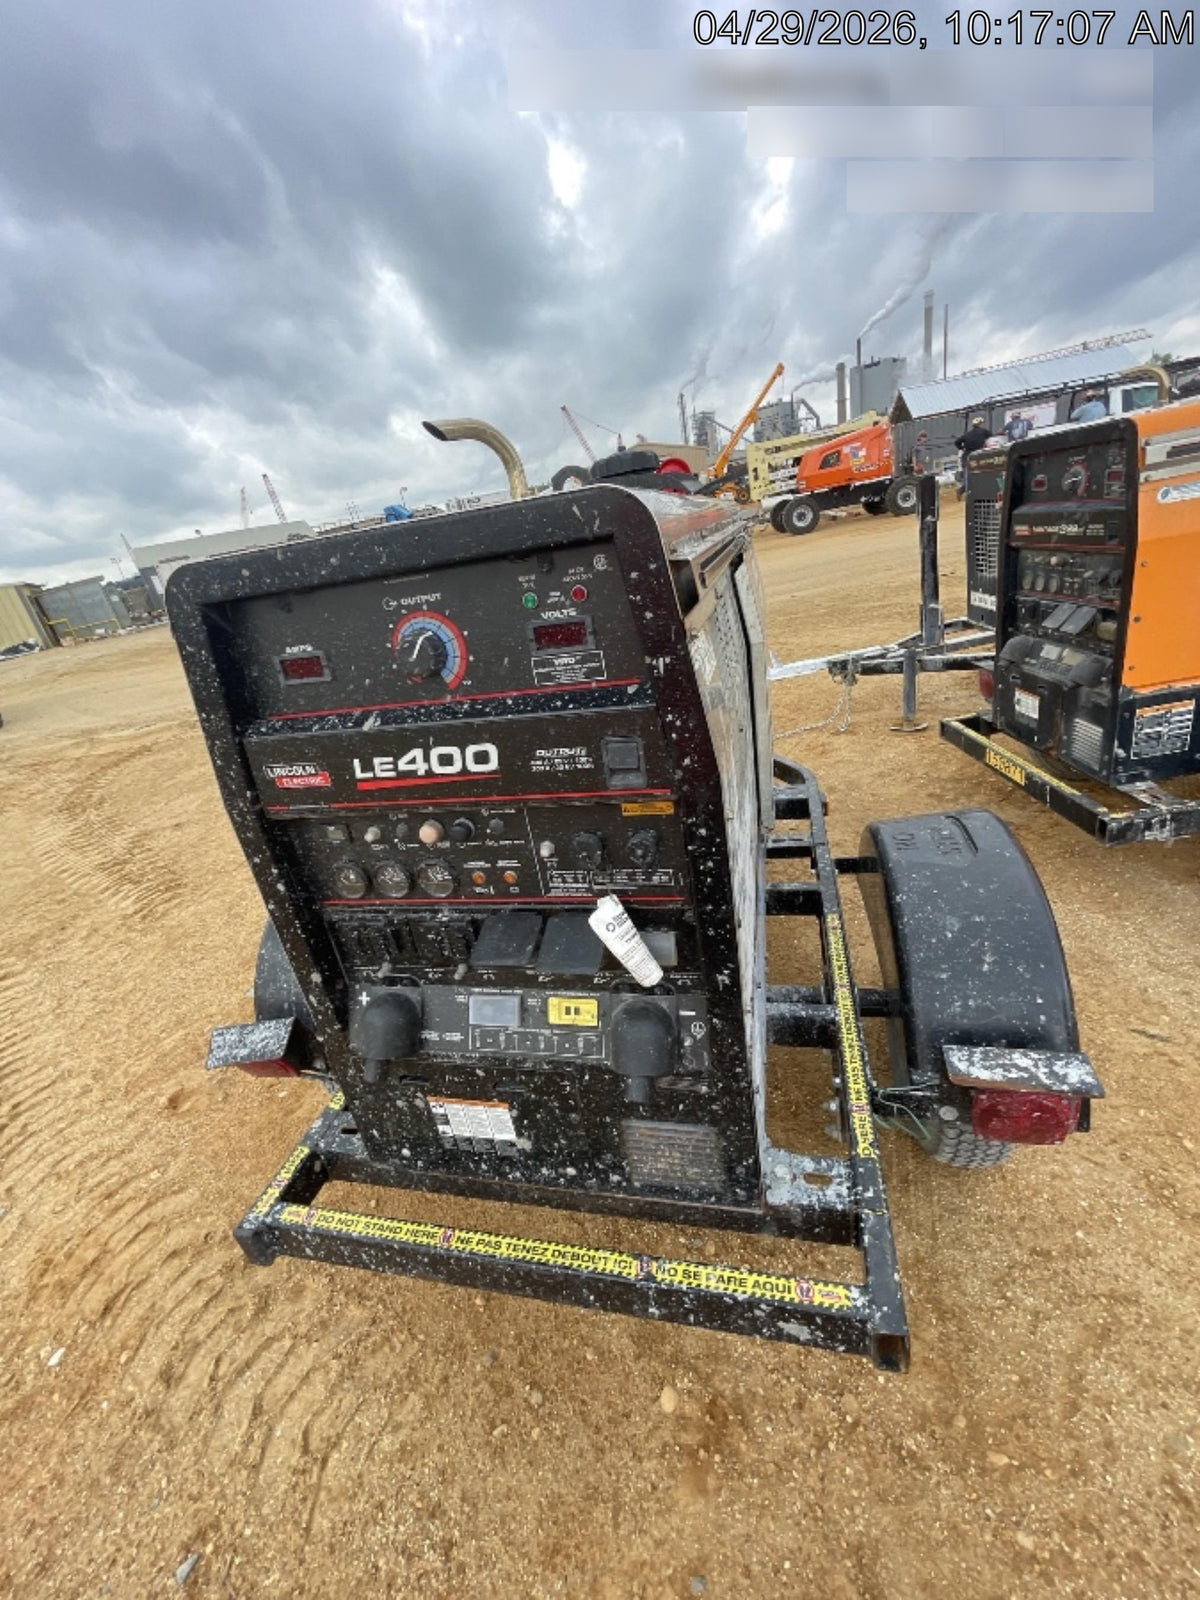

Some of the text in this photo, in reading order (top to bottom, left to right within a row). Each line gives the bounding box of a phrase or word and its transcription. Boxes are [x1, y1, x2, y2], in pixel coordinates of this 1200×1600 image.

[400, 592, 441, 605] OUTPUT
[540, 607, 577, 620] VOLTS
[265, 765, 316, 778] LINCOLN
[353, 742, 499, 779] LE400
[317, 1214, 439, 1240] DO NOT STAND HERE
[455, 1235, 632, 1270] NE PAS TENEZ DEBOUT ICI
[655, 1265, 678, 1278] NO
[682, 1268, 701, 1281] SE
[706, 1272, 748, 1288] PARE
